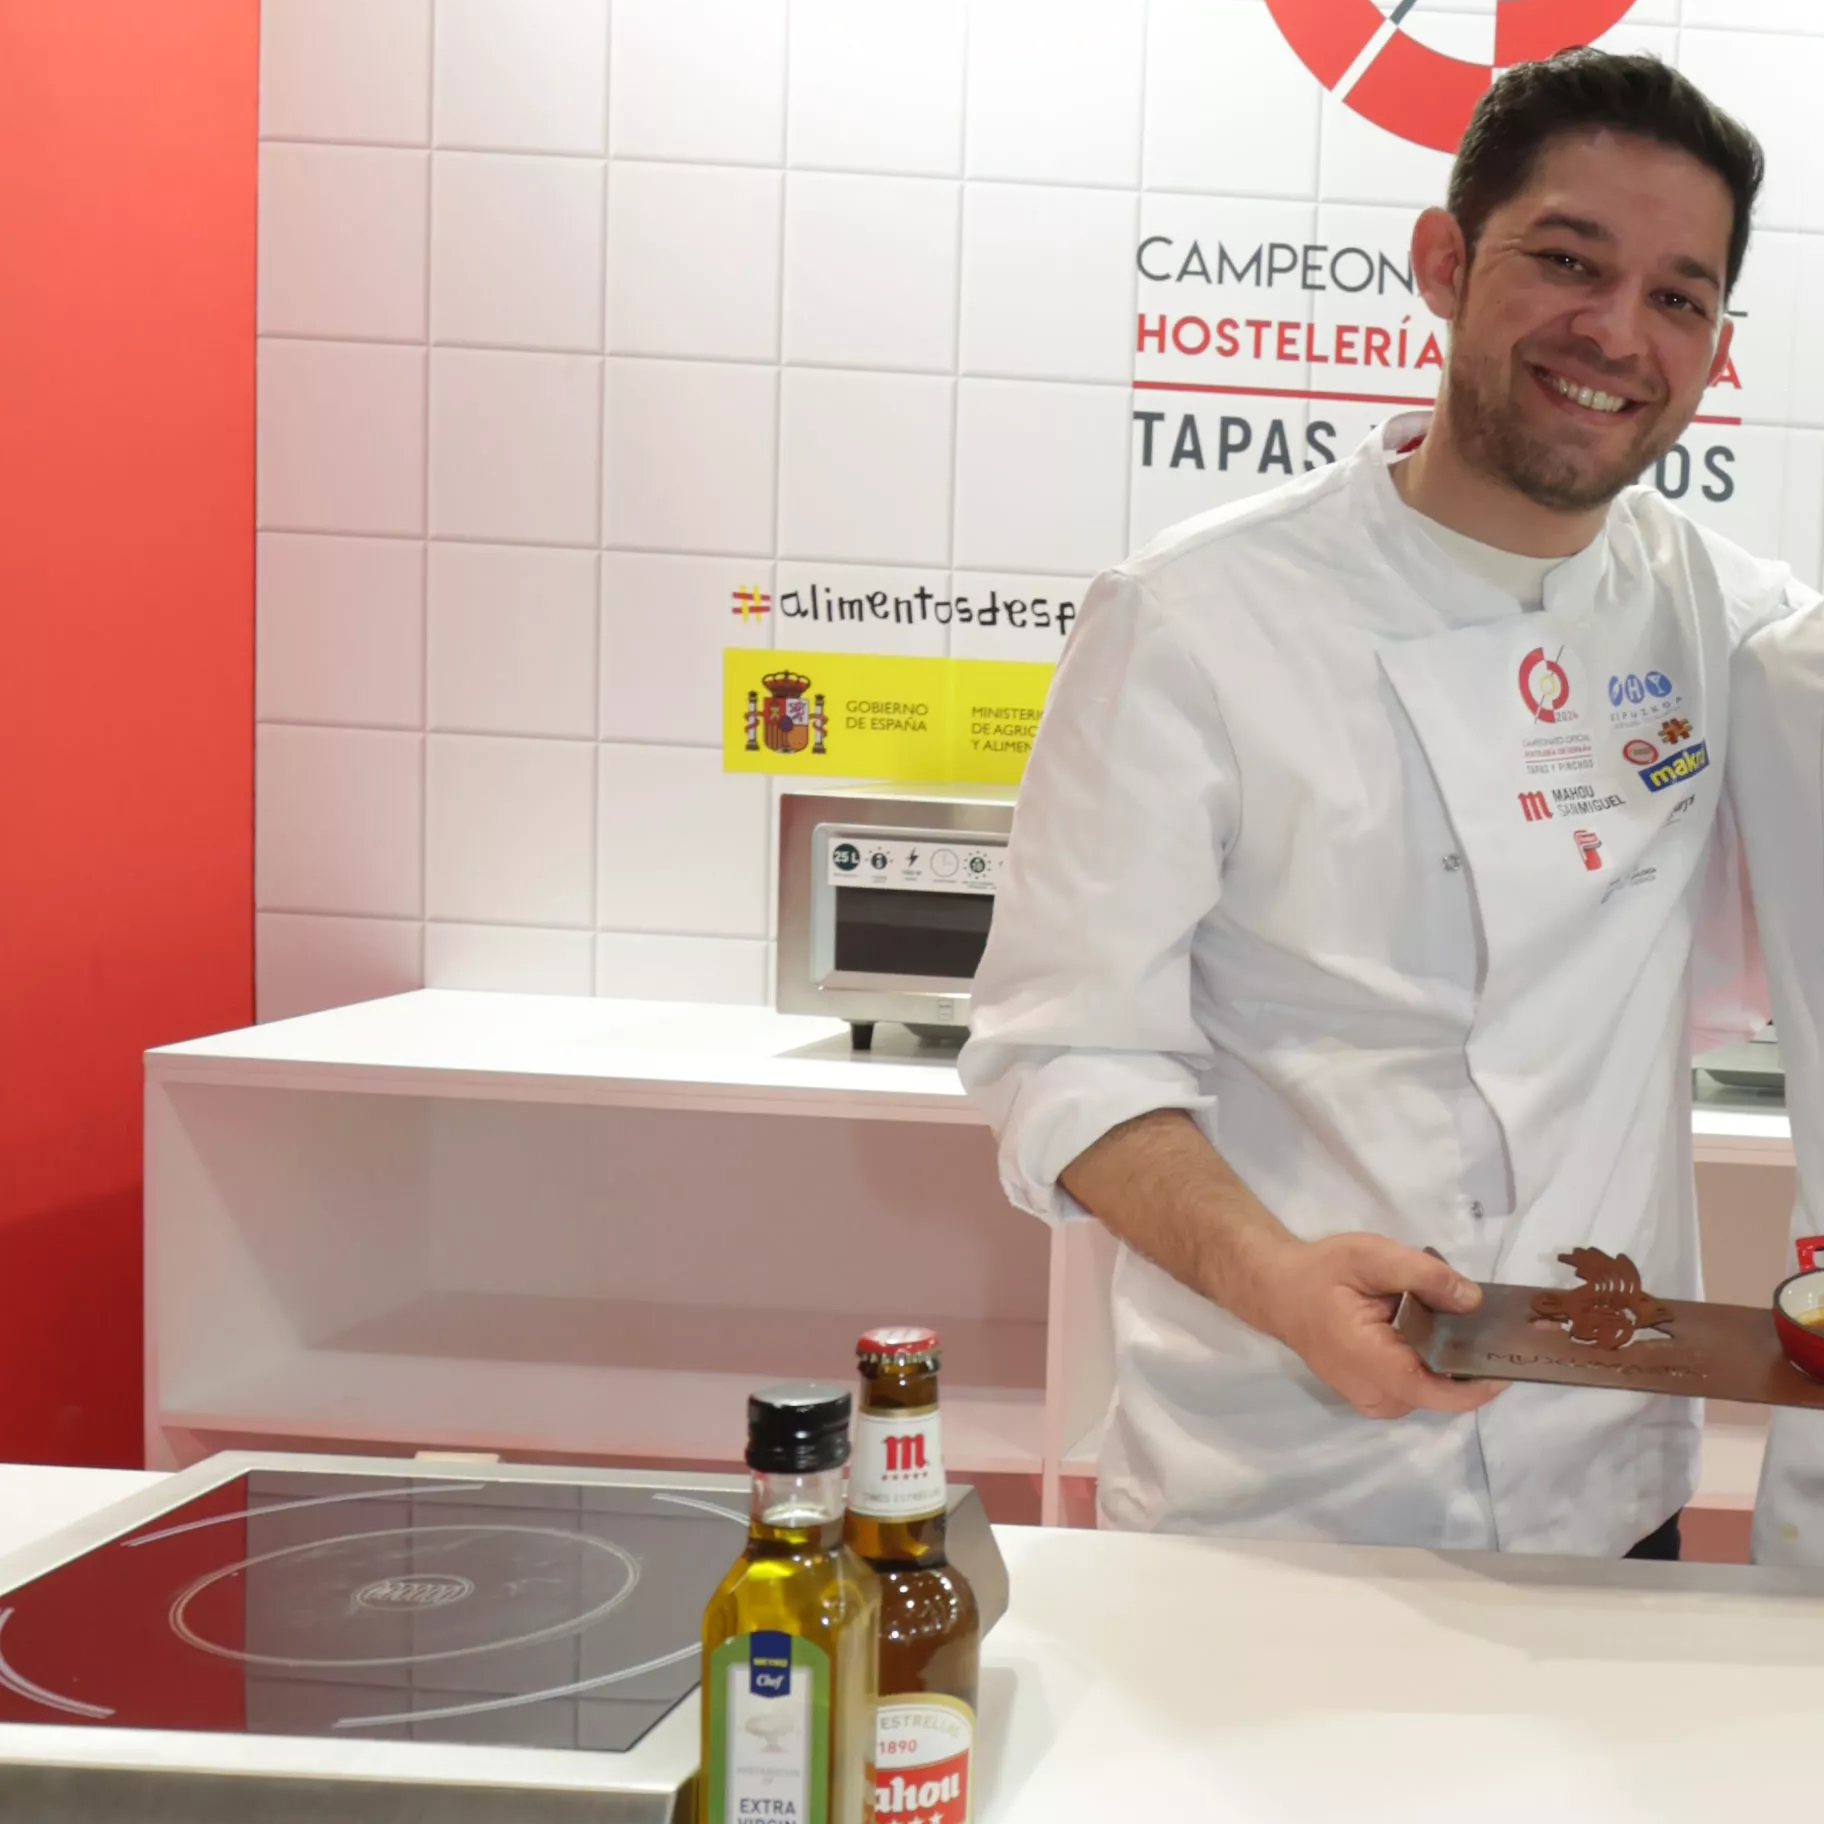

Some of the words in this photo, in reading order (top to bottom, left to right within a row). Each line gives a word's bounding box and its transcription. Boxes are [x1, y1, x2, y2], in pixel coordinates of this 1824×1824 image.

[1136, 236, 1415, 295] CAMPEON
[1136, 313, 1443, 370] HOSTELERÍA
[1132, 410, 1338, 475] TAPAS
[732, 584, 1075, 635] #alimentosdesp
[846, 700, 928, 717] GOBIERNO
[971, 706, 1043, 720] MINISTERI
[846, 717, 867, 730] DE
[870, 717, 927, 732] ESPAÑA
[971, 723, 990, 736] DE
[1552, 785, 1595, 802] MAHOU
[756, 1673, 784, 1690] Chef
[879, 1740, 917, 1755] 1890
[875, 1773, 960, 1813] ahou
[740, 1799, 796, 1815] EXTRA
